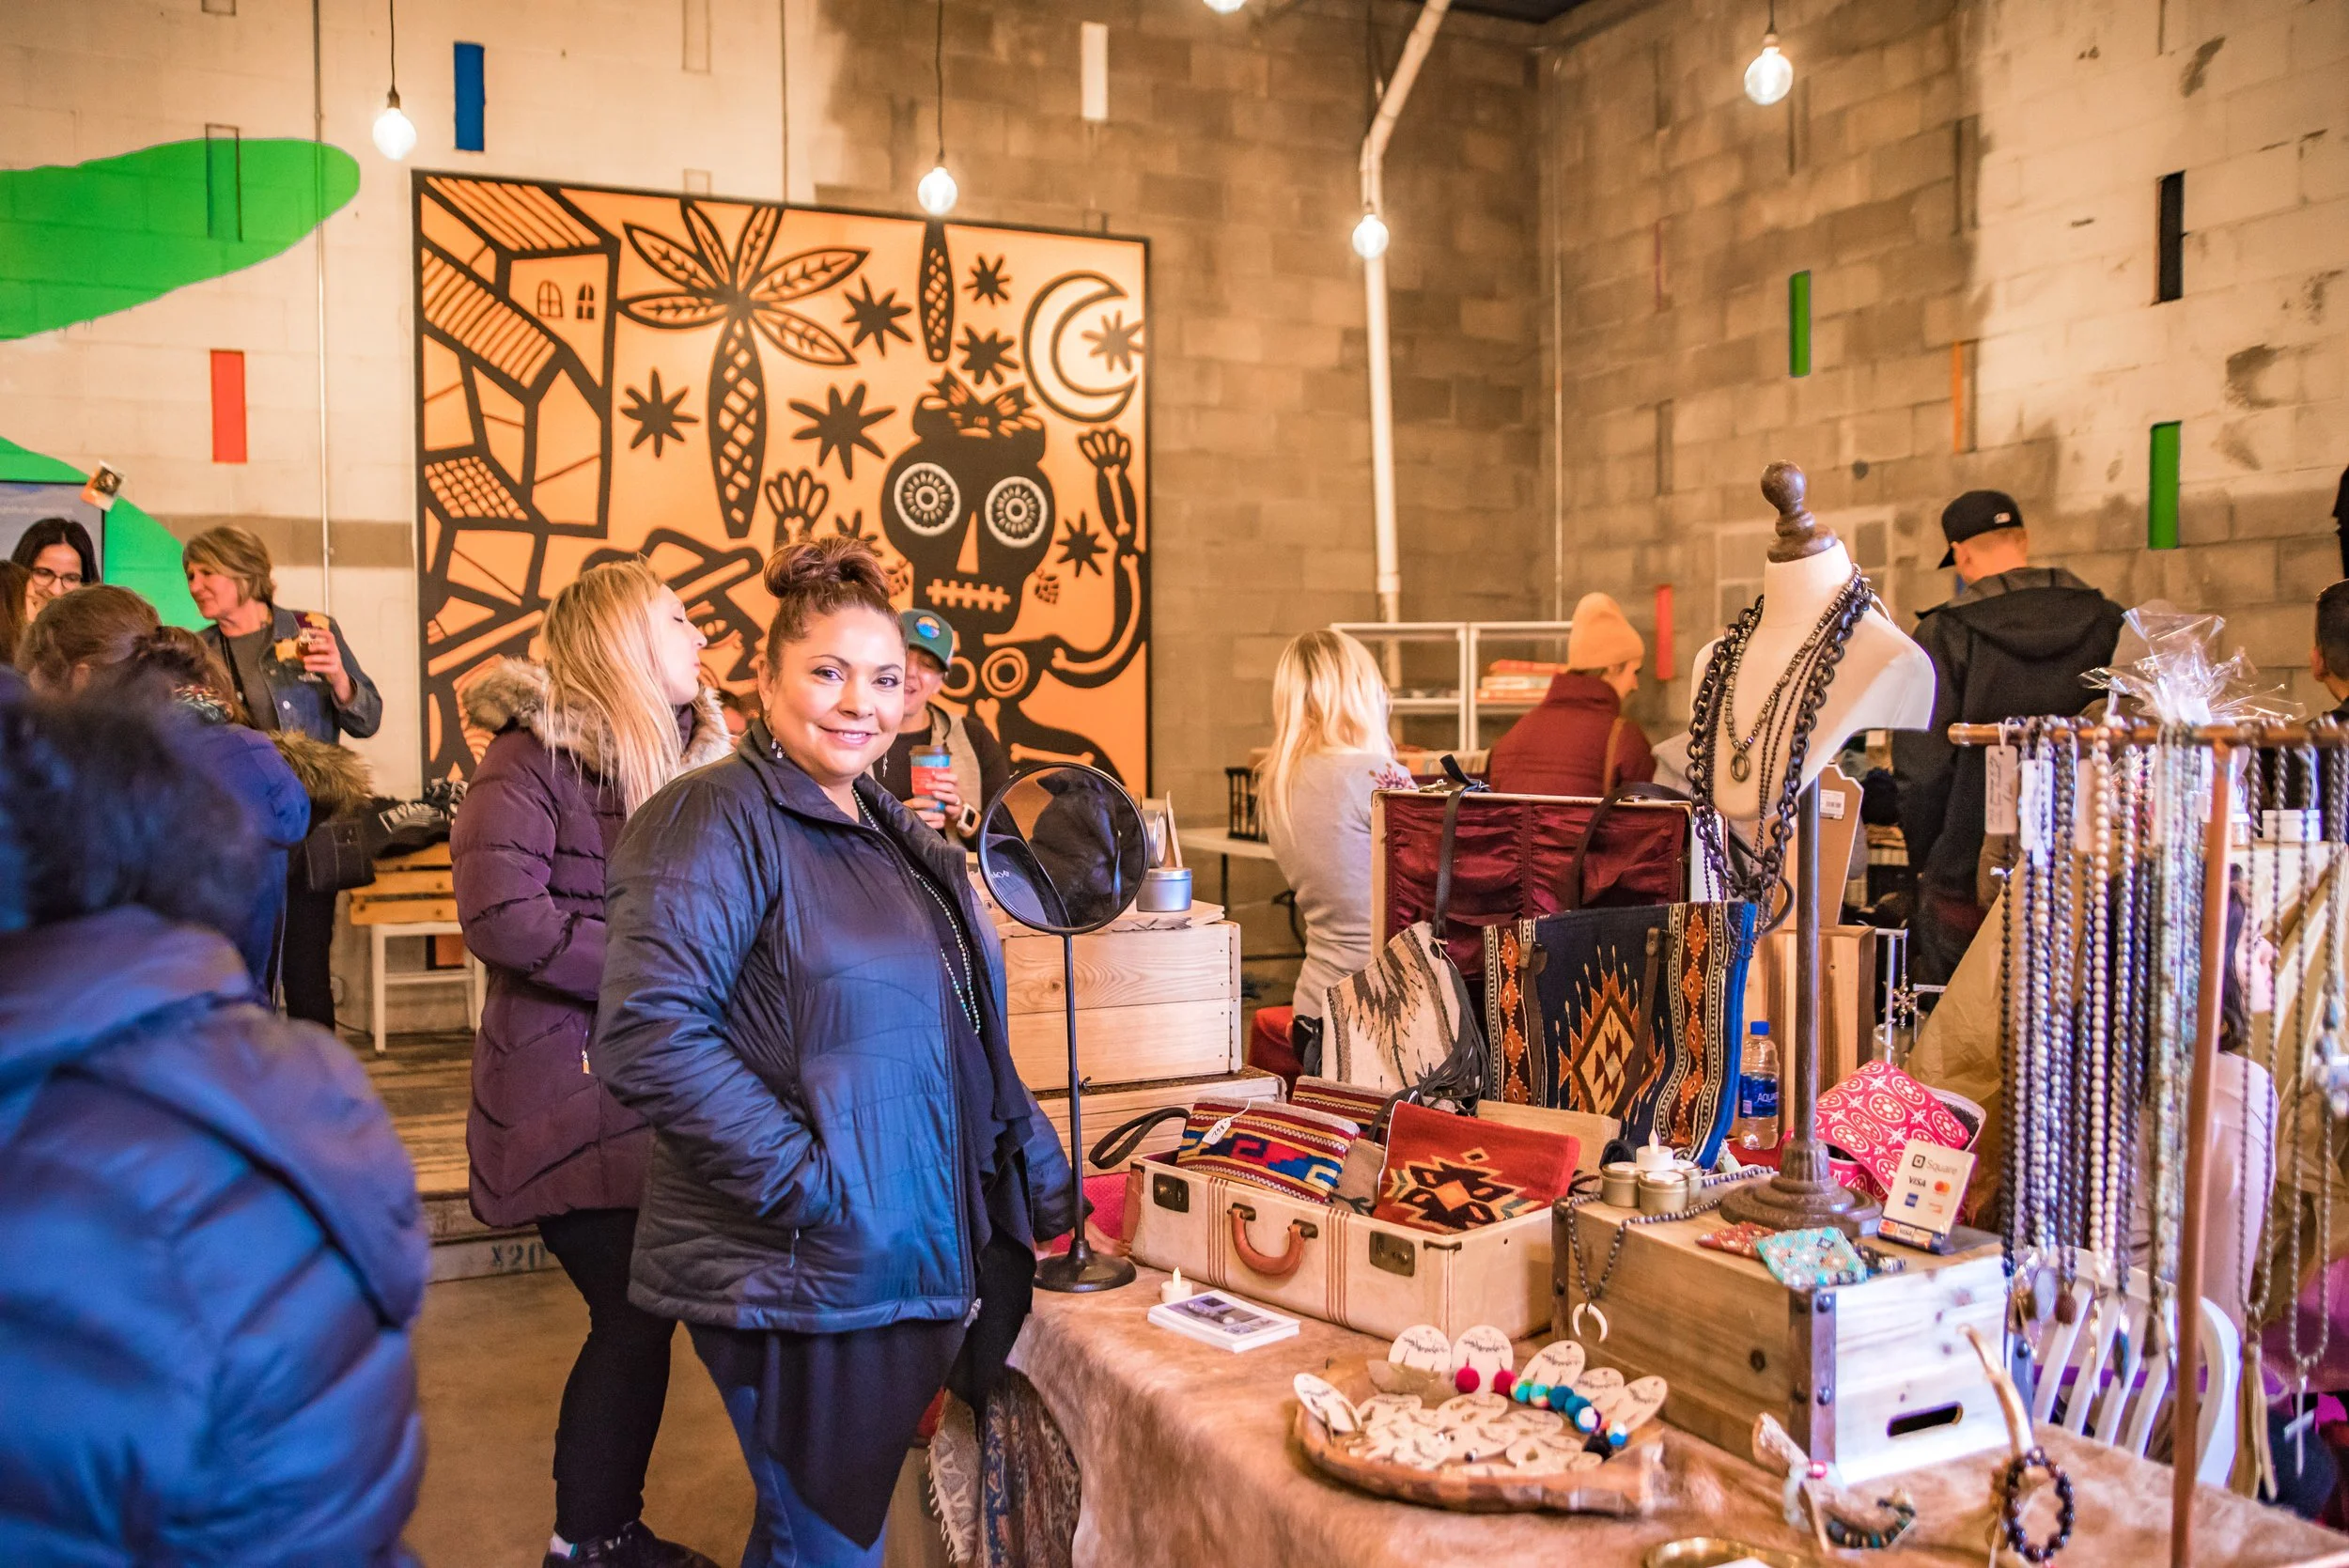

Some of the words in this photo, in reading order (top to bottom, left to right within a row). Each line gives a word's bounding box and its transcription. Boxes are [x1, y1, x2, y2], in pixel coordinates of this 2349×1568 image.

[1926, 1159, 1958, 1174] Square
[1908, 1176, 1926, 1188] VISA
[1899, 1228, 1912, 1236] VISA
